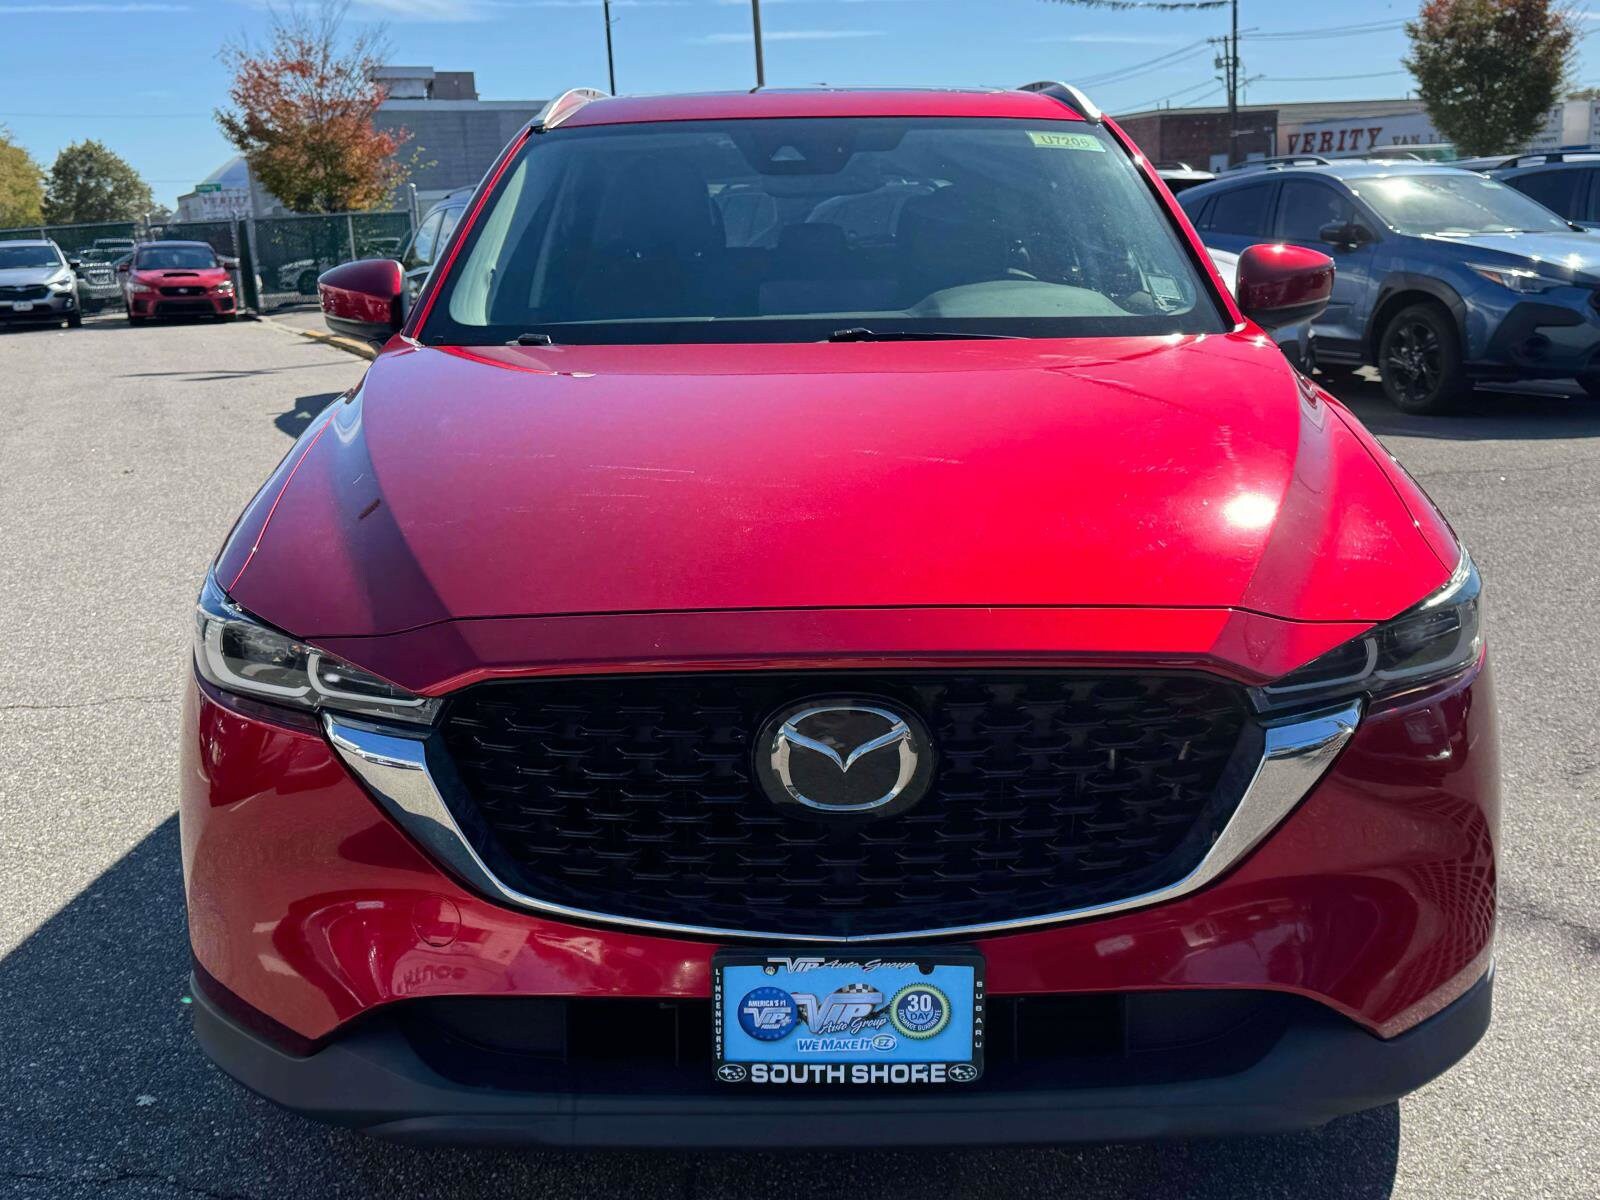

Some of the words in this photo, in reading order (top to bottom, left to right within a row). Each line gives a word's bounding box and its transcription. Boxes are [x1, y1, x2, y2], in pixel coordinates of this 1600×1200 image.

[1288, 127, 1383, 155] VERITY
[767, 957, 825, 974] VIP
[821, 959, 859, 969] Auto
[862, 958, 916, 973] Group
[714, 967, 722, 1060] LINDENHURST
[791, 992, 883, 1034] VIP
[907, 994, 932, 1012] 30
[743, 1006, 792, 1028] VIP
[910, 1012, 930, 1020] DAY
[974, 981, 983, 1048] SUBARU
[818, 1020, 848, 1034] Auto
[850, 1017, 888, 1035] Group
[751, 1063, 845, 1084] SOUTH
[851, 1063, 947, 1084] SHORE
